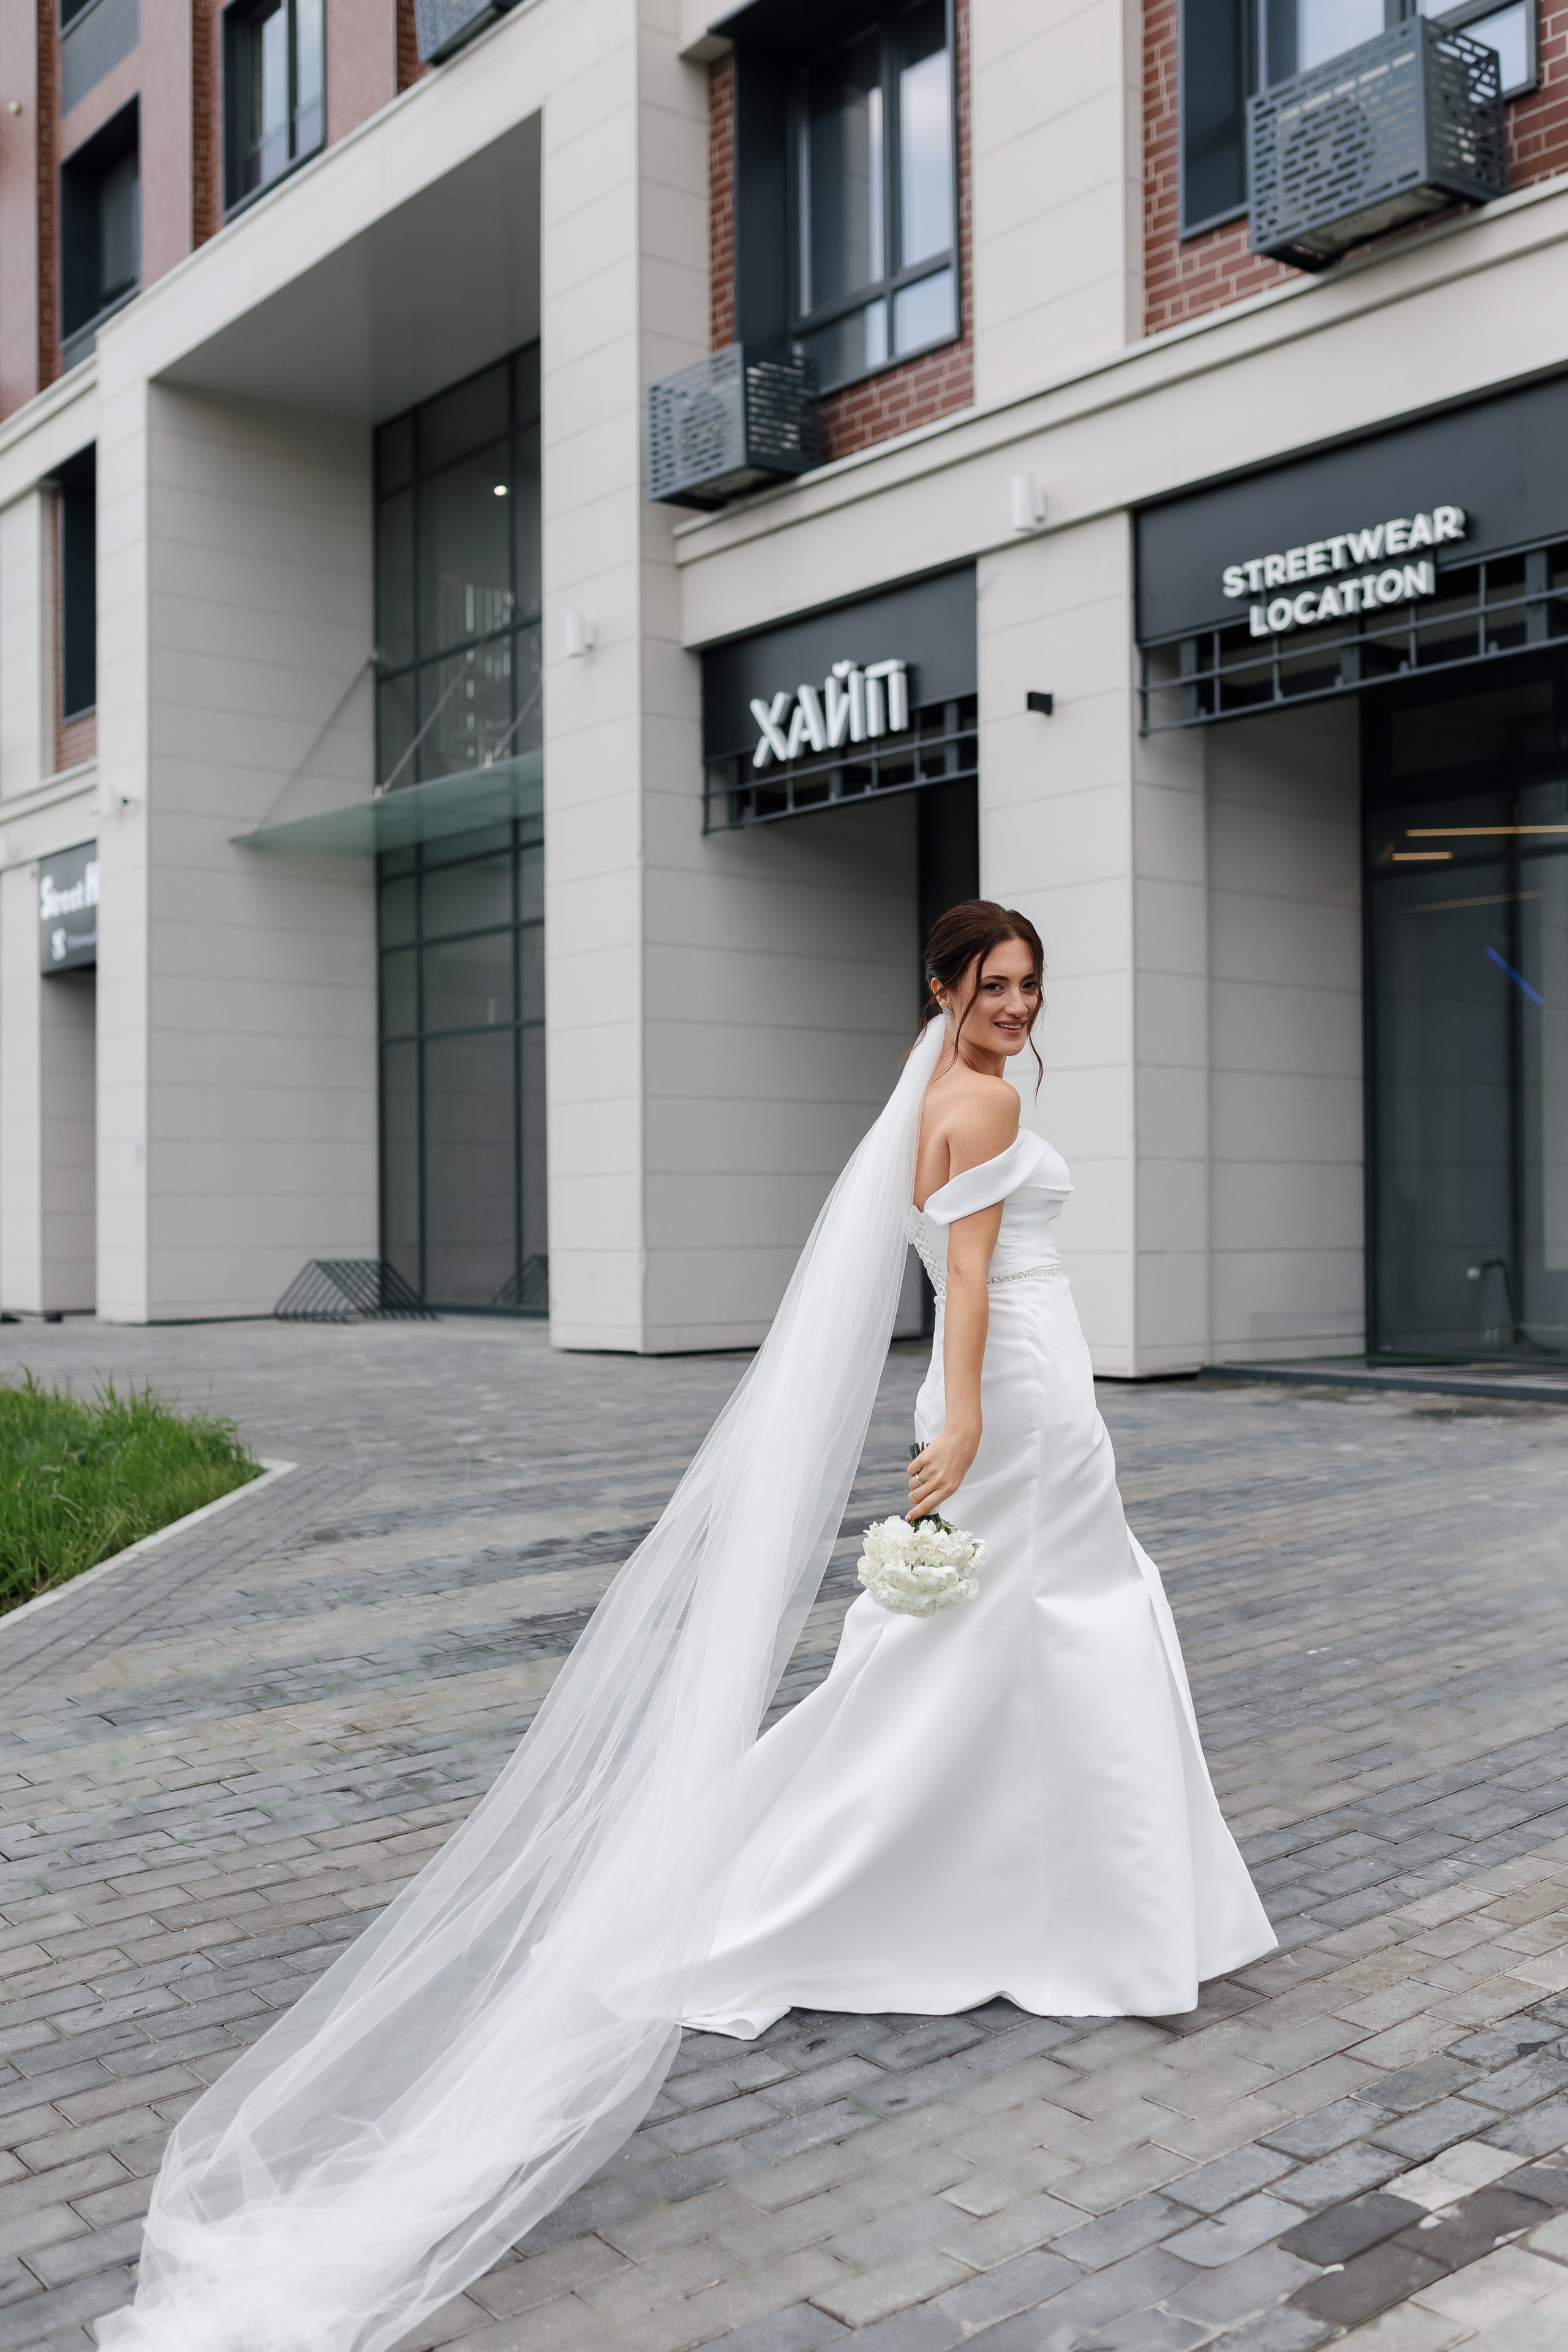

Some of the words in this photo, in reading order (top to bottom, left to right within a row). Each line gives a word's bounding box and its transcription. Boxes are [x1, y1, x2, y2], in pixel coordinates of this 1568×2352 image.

[1223, 505, 1466, 598] STREETWEAR
[1250, 560, 1436, 637] LOCATION
[749, 658, 908, 767] ХАЙП
